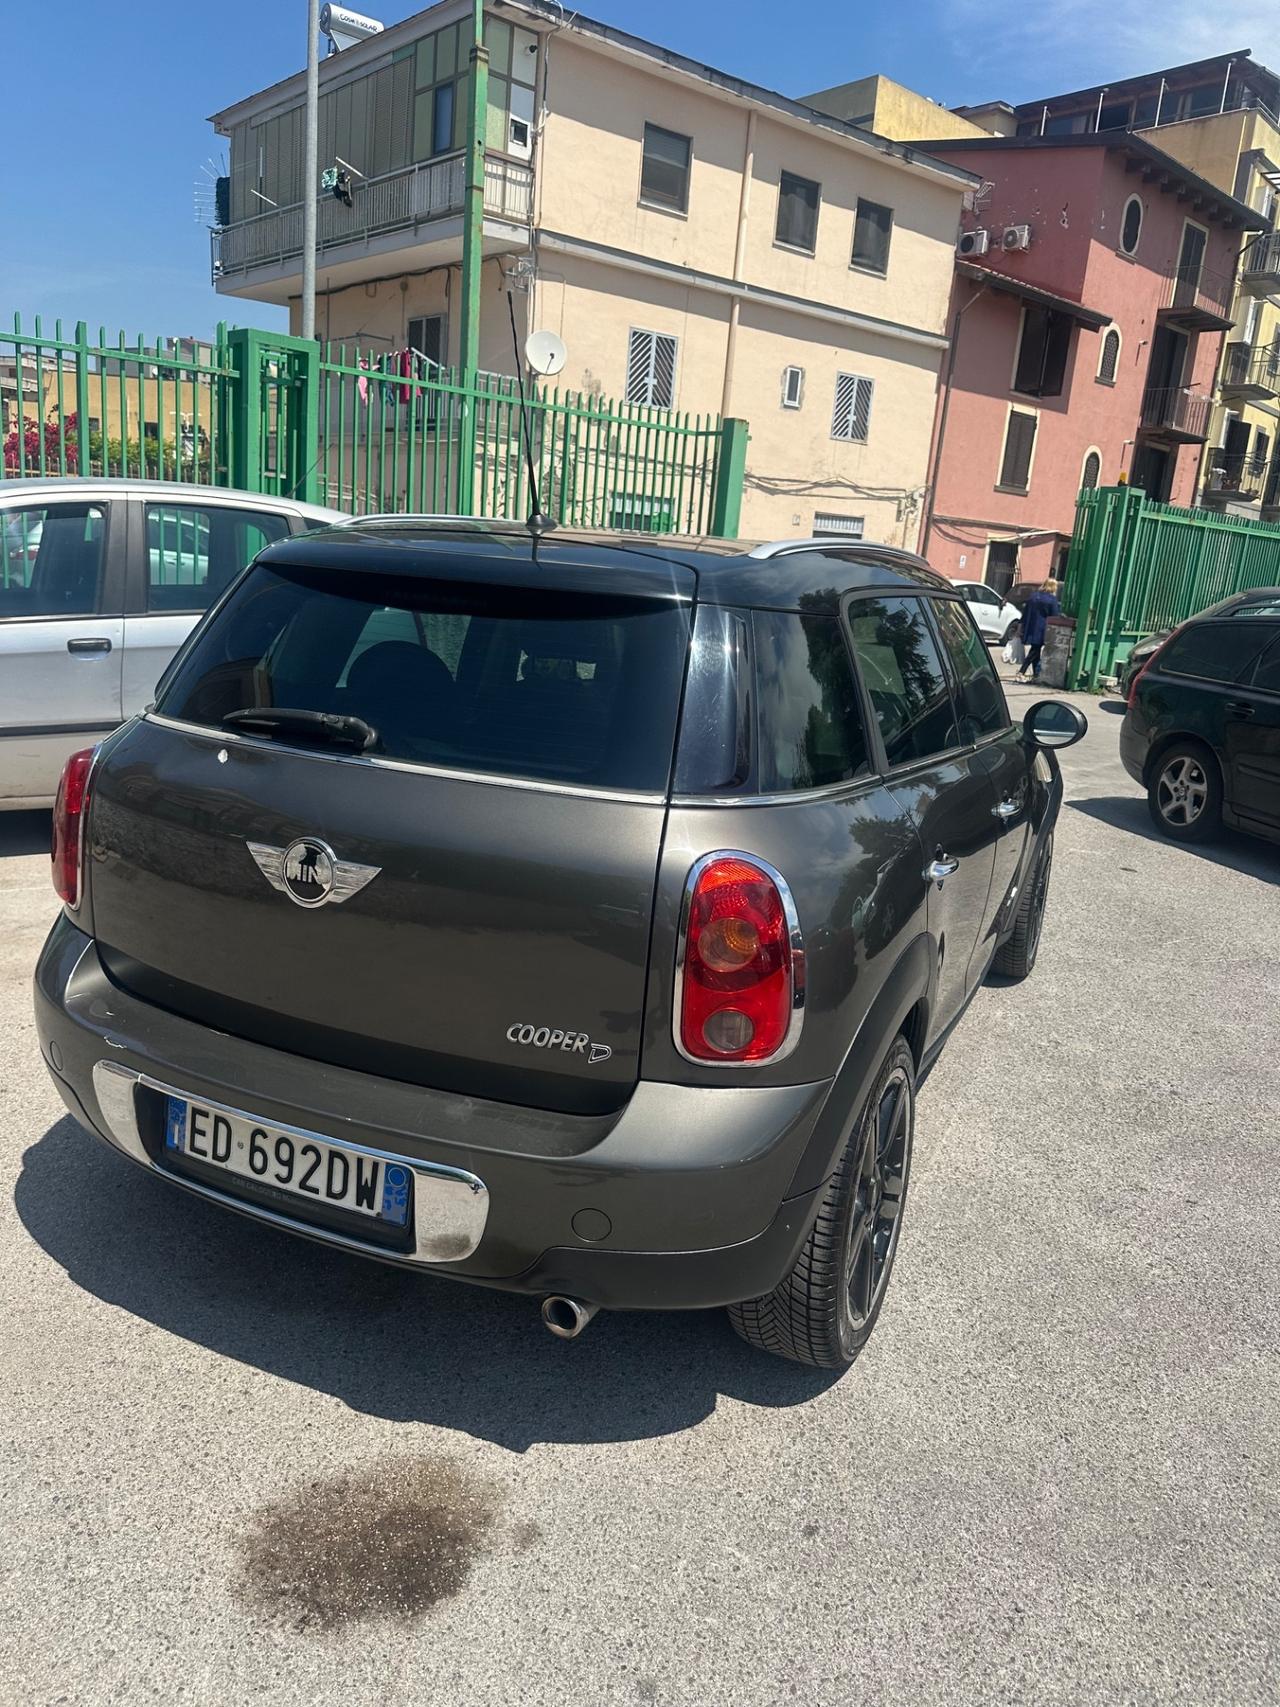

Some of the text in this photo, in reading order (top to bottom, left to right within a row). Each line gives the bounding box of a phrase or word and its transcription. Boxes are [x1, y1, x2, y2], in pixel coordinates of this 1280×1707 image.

[506, 1022, 612, 1064] COOPER D
[189, 1106, 233, 1163] ED
[248, 1128, 380, 1211] 692DW
